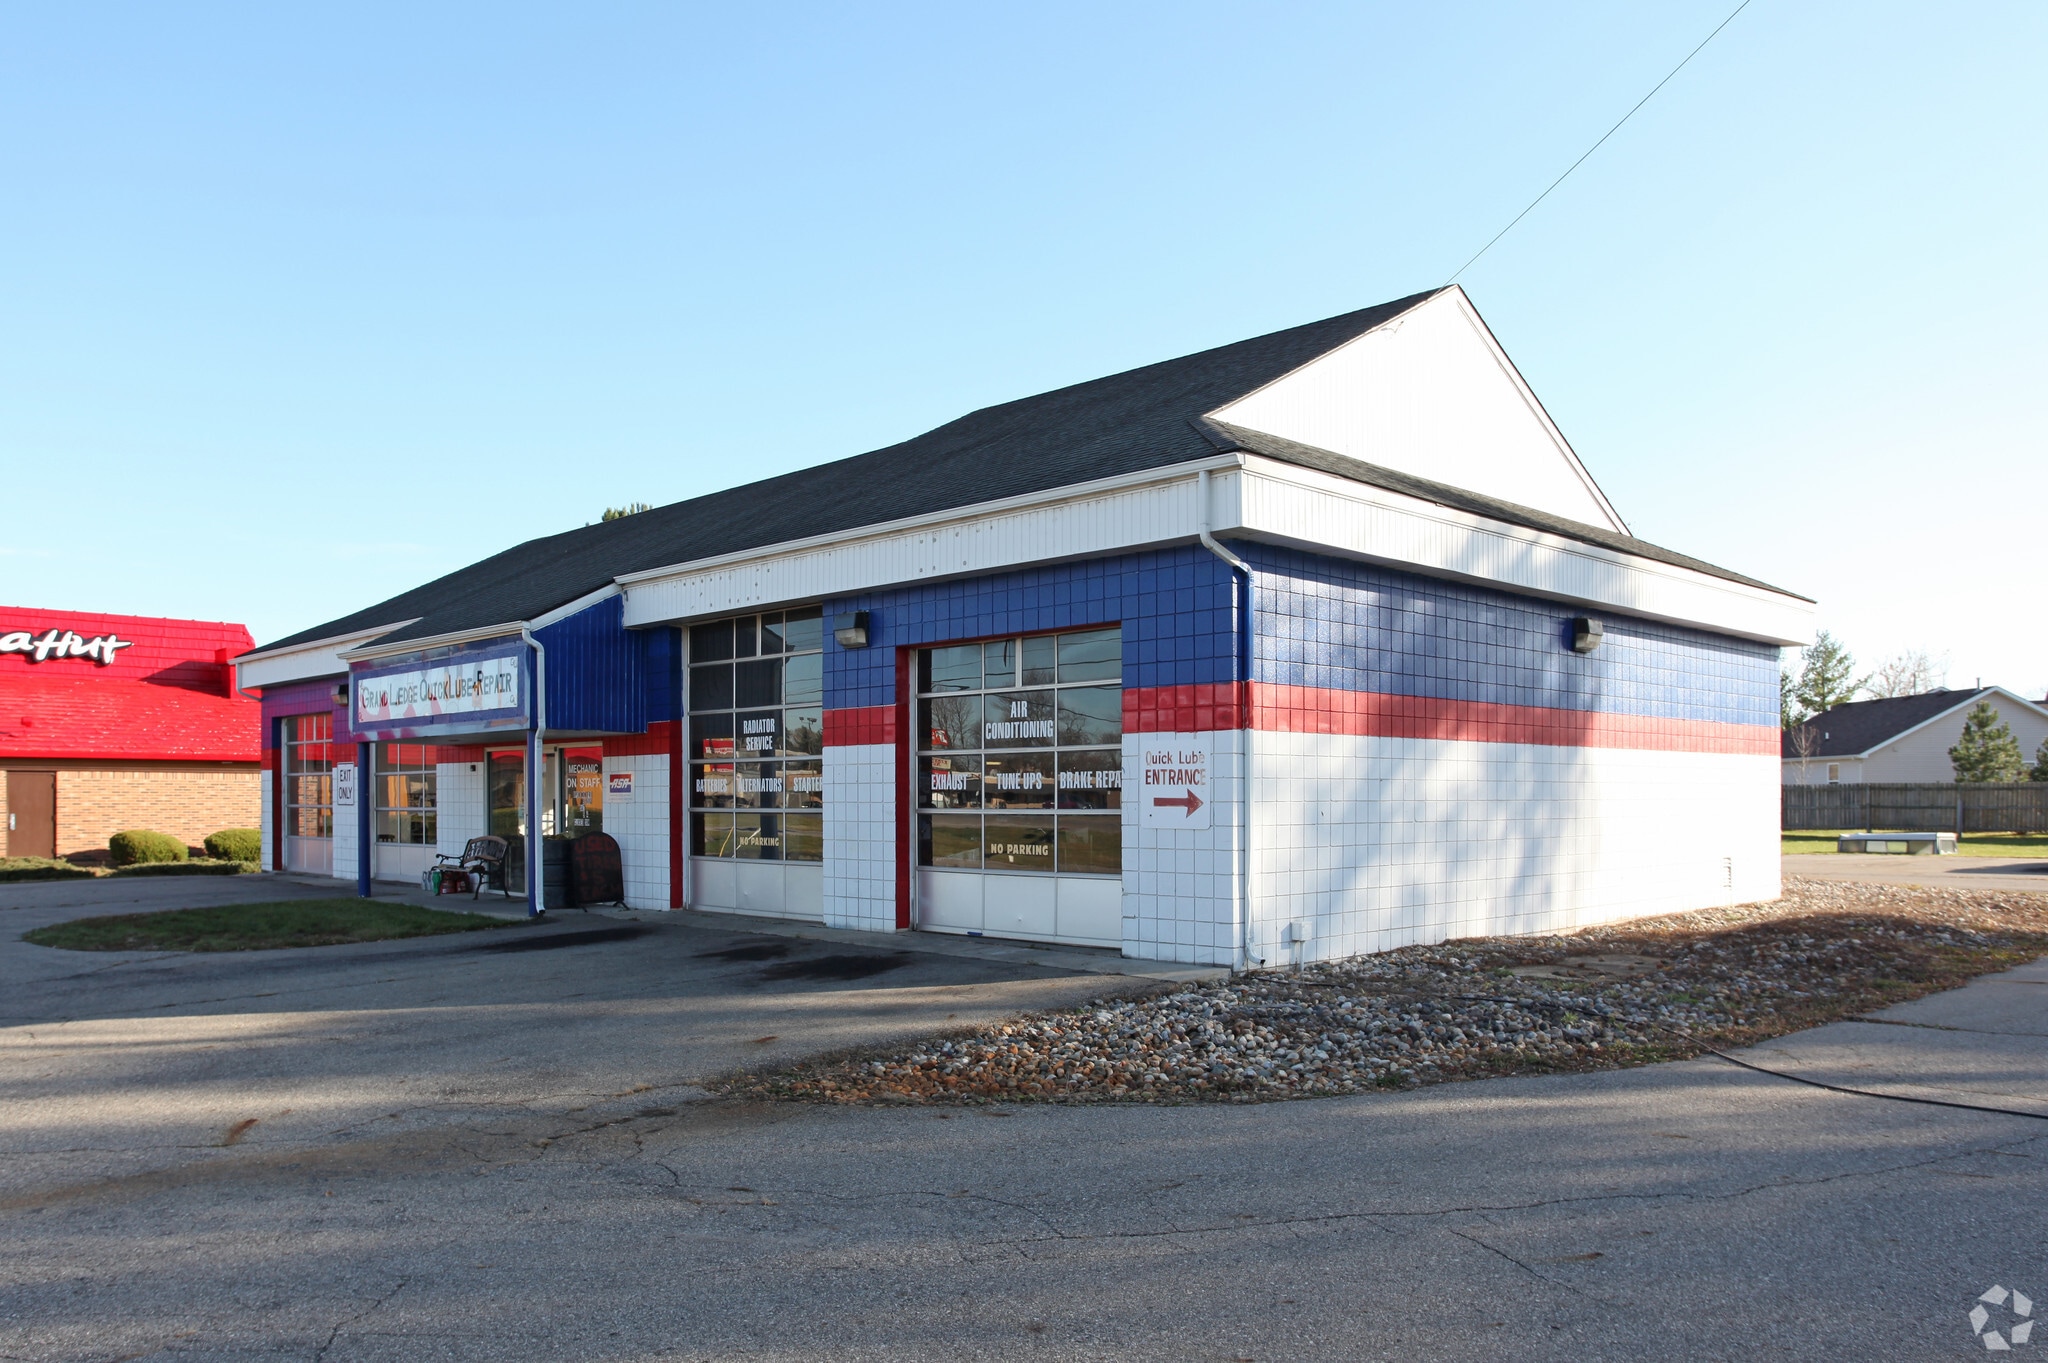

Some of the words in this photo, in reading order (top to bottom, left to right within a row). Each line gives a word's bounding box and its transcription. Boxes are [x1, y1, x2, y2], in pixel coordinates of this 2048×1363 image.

[361, 686, 388, 708] GRAND
[389, 682, 418, 706] LEDGE
[419, 678, 449, 701] QUICK
[1010, 700, 1028, 718] AIR
[743, 718, 775, 734] RADIATOR
[985, 720, 1054, 740] CONDITIONING
[746, 735, 773, 751] SERVICE
[1145, 750, 1173, 766] Quick
[1179, 750, 1205, 764] Lube
[340, 769, 351, 782] EXIT
[568, 764, 598, 774] MECHANIC
[1145, 768, 1206, 785] ENTRANCE
[567, 778, 577, 788] ON
[580, 778, 600, 788] STAFF
[696, 778, 728, 793] BATTERIES
[738, 777, 783, 793] ALTERNATORS
[931, 773, 967, 790] EXHAUST
[997, 773, 1021, 790] TUNE
[1023, 772, 1043, 790] UPS
[1060, 771, 1093, 789] BRAKE
[339, 786, 352, 799] ONLY
[740, 837, 749, 846] NO
[751, 837, 780, 847] PARKING
[990, 843, 1004, 854] NO
[1006, 843, 1049, 856] PARKING
